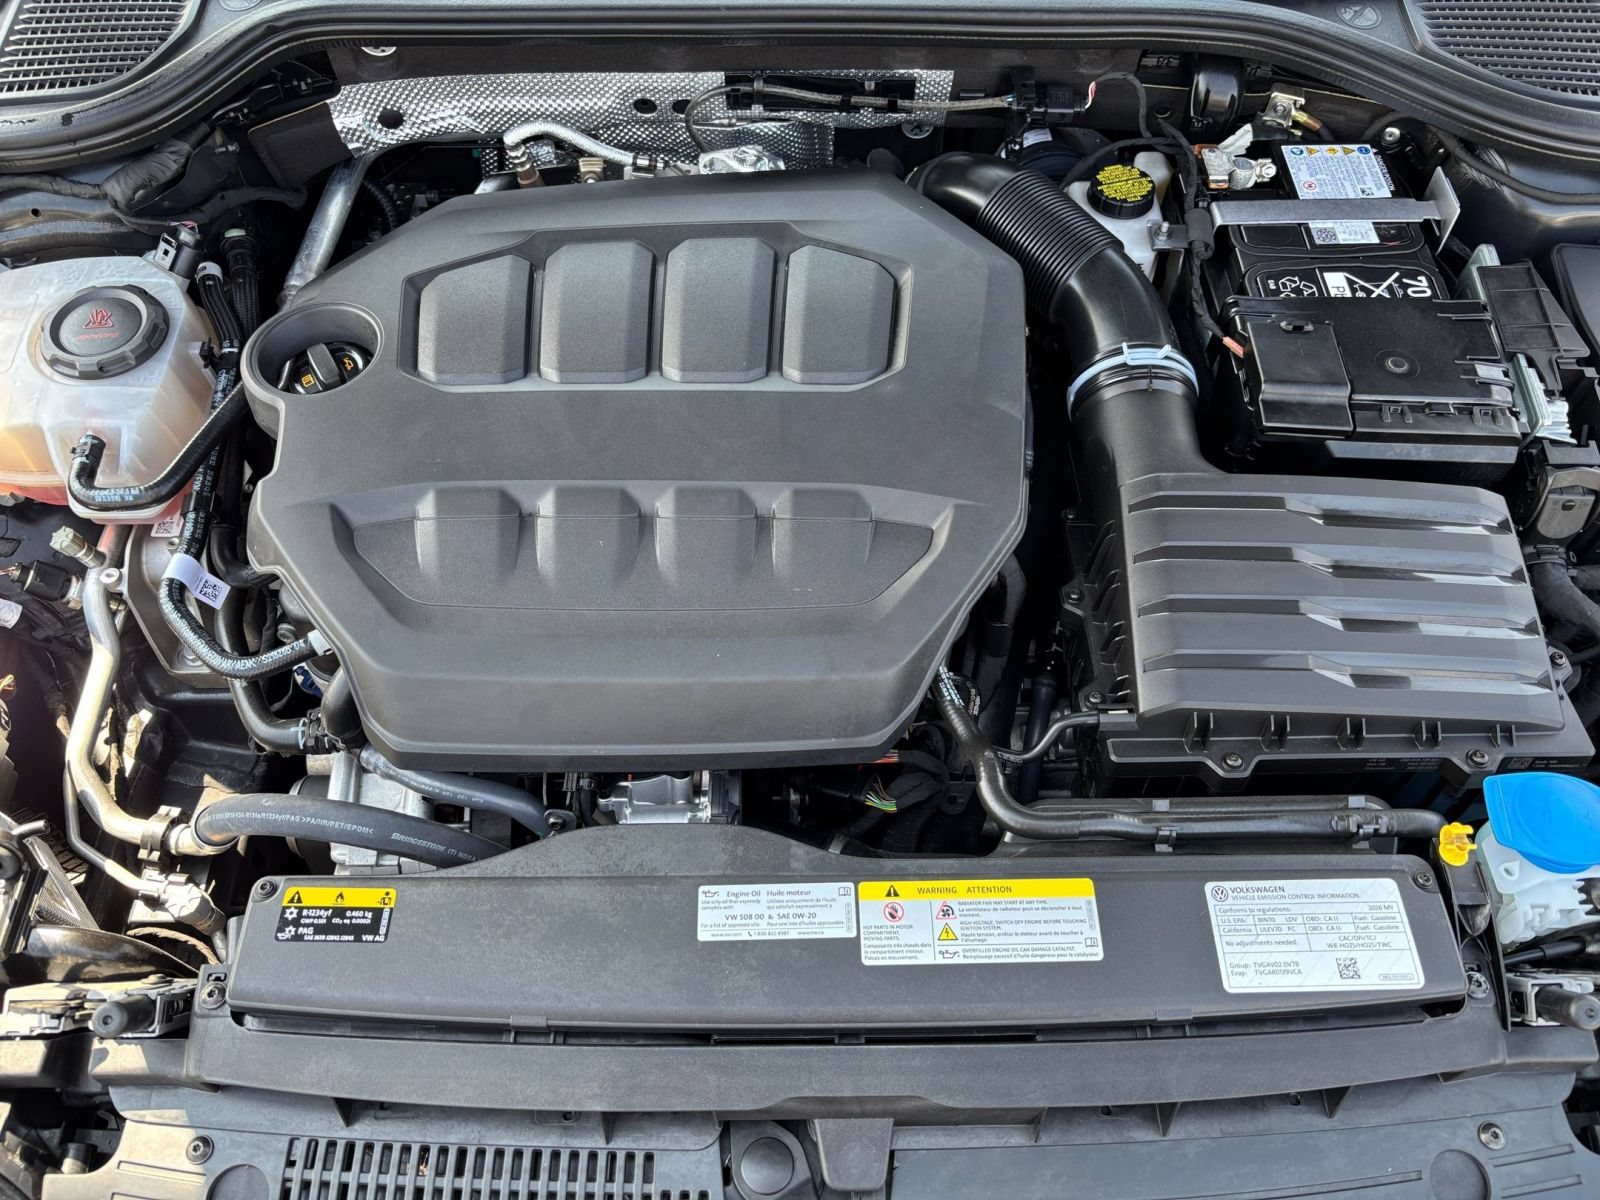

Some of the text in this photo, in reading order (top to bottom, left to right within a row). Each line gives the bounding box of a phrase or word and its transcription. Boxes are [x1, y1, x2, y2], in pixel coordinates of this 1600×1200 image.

[1402, 275, 1432, 298] 70
[391, 831, 446, 852] BRIDGESTONE
[726, 890, 751, 899] Engine
[751, 889, 761, 897] Oil
[766, 889, 784, 897] Huile
[917, 886, 1012, 895] WARNING ATTENTION
[1229, 886, 1285, 894] VOLKSWAGEN
[302, 908, 333, 918] R-1234yf
[364, 910, 373, 919] kg
[297, 926, 314, 935] PAG
[361, 934, 375, 942] VW
[374, 934, 385, 942] AG
[1235, 939, 1273, 948] adjustments
